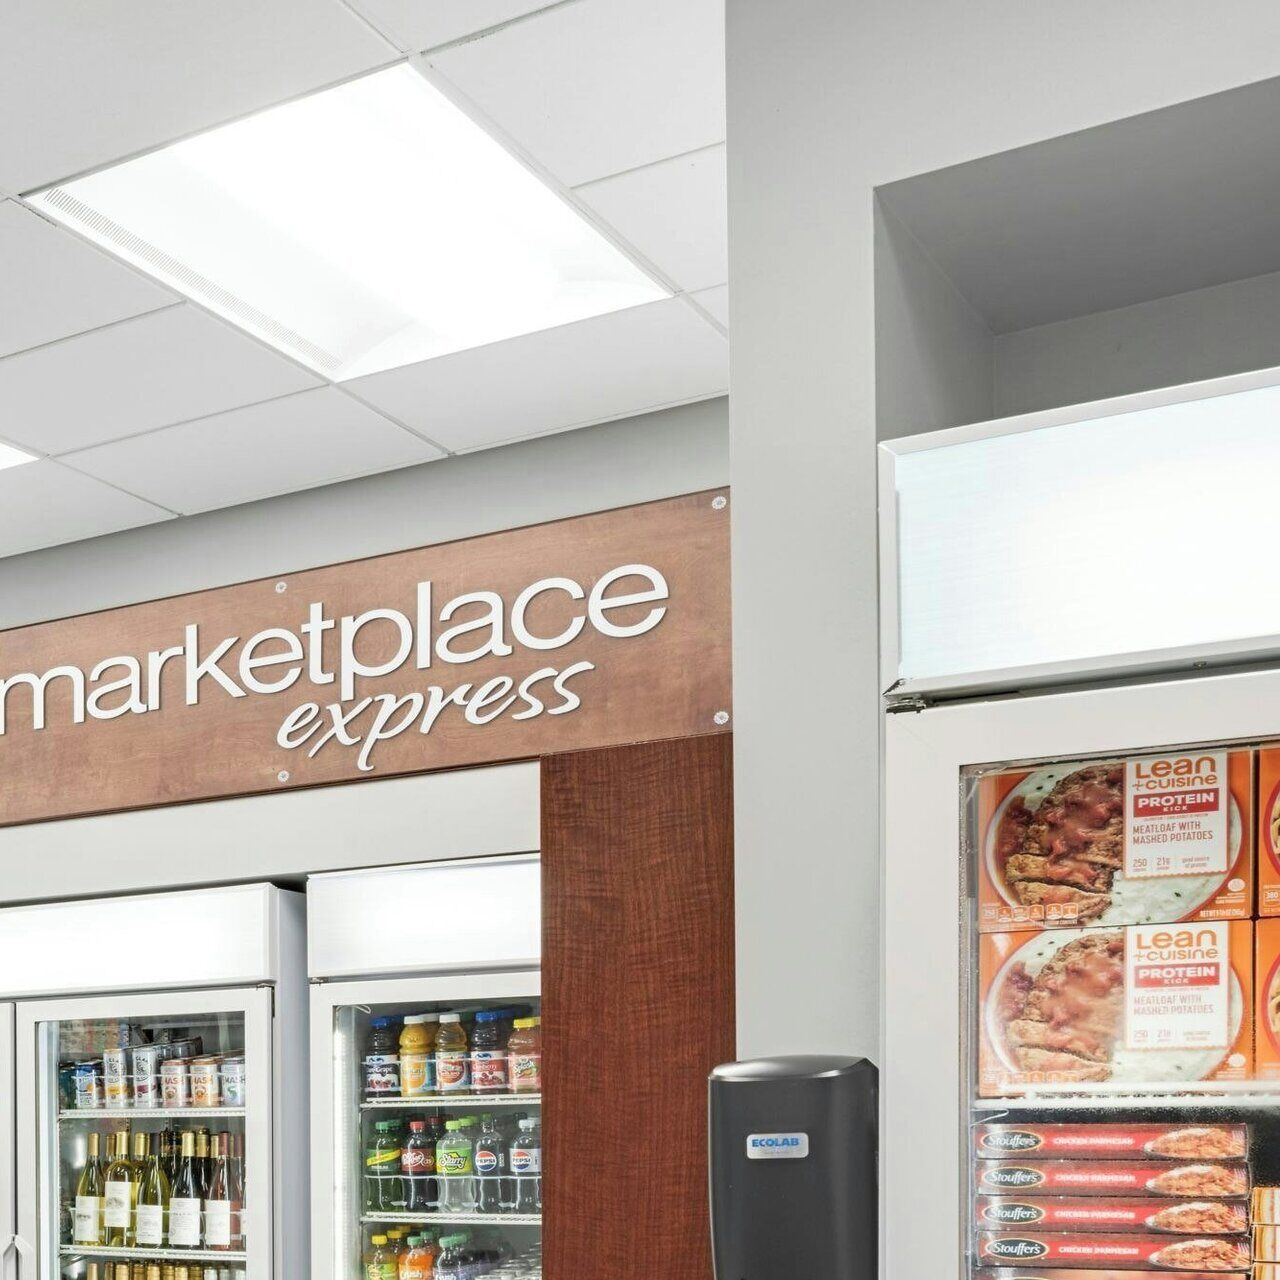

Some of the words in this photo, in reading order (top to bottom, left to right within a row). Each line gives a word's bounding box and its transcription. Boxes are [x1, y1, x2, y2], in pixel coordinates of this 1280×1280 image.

[277, 658, 596, 771] express
[1135, 755, 1216, 779] Lean
[1138, 792, 1215, 808] PROTEIN
[1133, 822, 1176, 834] MEATLOAF
[1179, 821, 1201, 831] WITH
[1133, 834, 1168, 845] MASHED
[1170, 831, 1213, 843] POTATOES
[1136, 929, 1217, 950] Lean
[1139, 966, 1216, 979] PROTEIN
[1134, 995, 1176, 1006] MEATLOAF
[1179, 994, 1201, 1003] WITH
[1134, 1005, 1168, 1015] MASHED
[1171, 1003, 1214, 1015] POTATOES
[752, 1138, 799, 1147] ECOLAB
[990, 1134, 1036, 1149] Stouffer's
[441, 1154, 466, 1168] Starry
[992, 1171, 1037, 1184] Stouffer's
[991, 1206, 1037, 1220] Stouffer's
[993, 1242, 1041, 1256] Stouffer's
[1058, 1246, 1092, 1255] CHICKEN
[1095, 1246, 1139, 1255] PARMESAN
